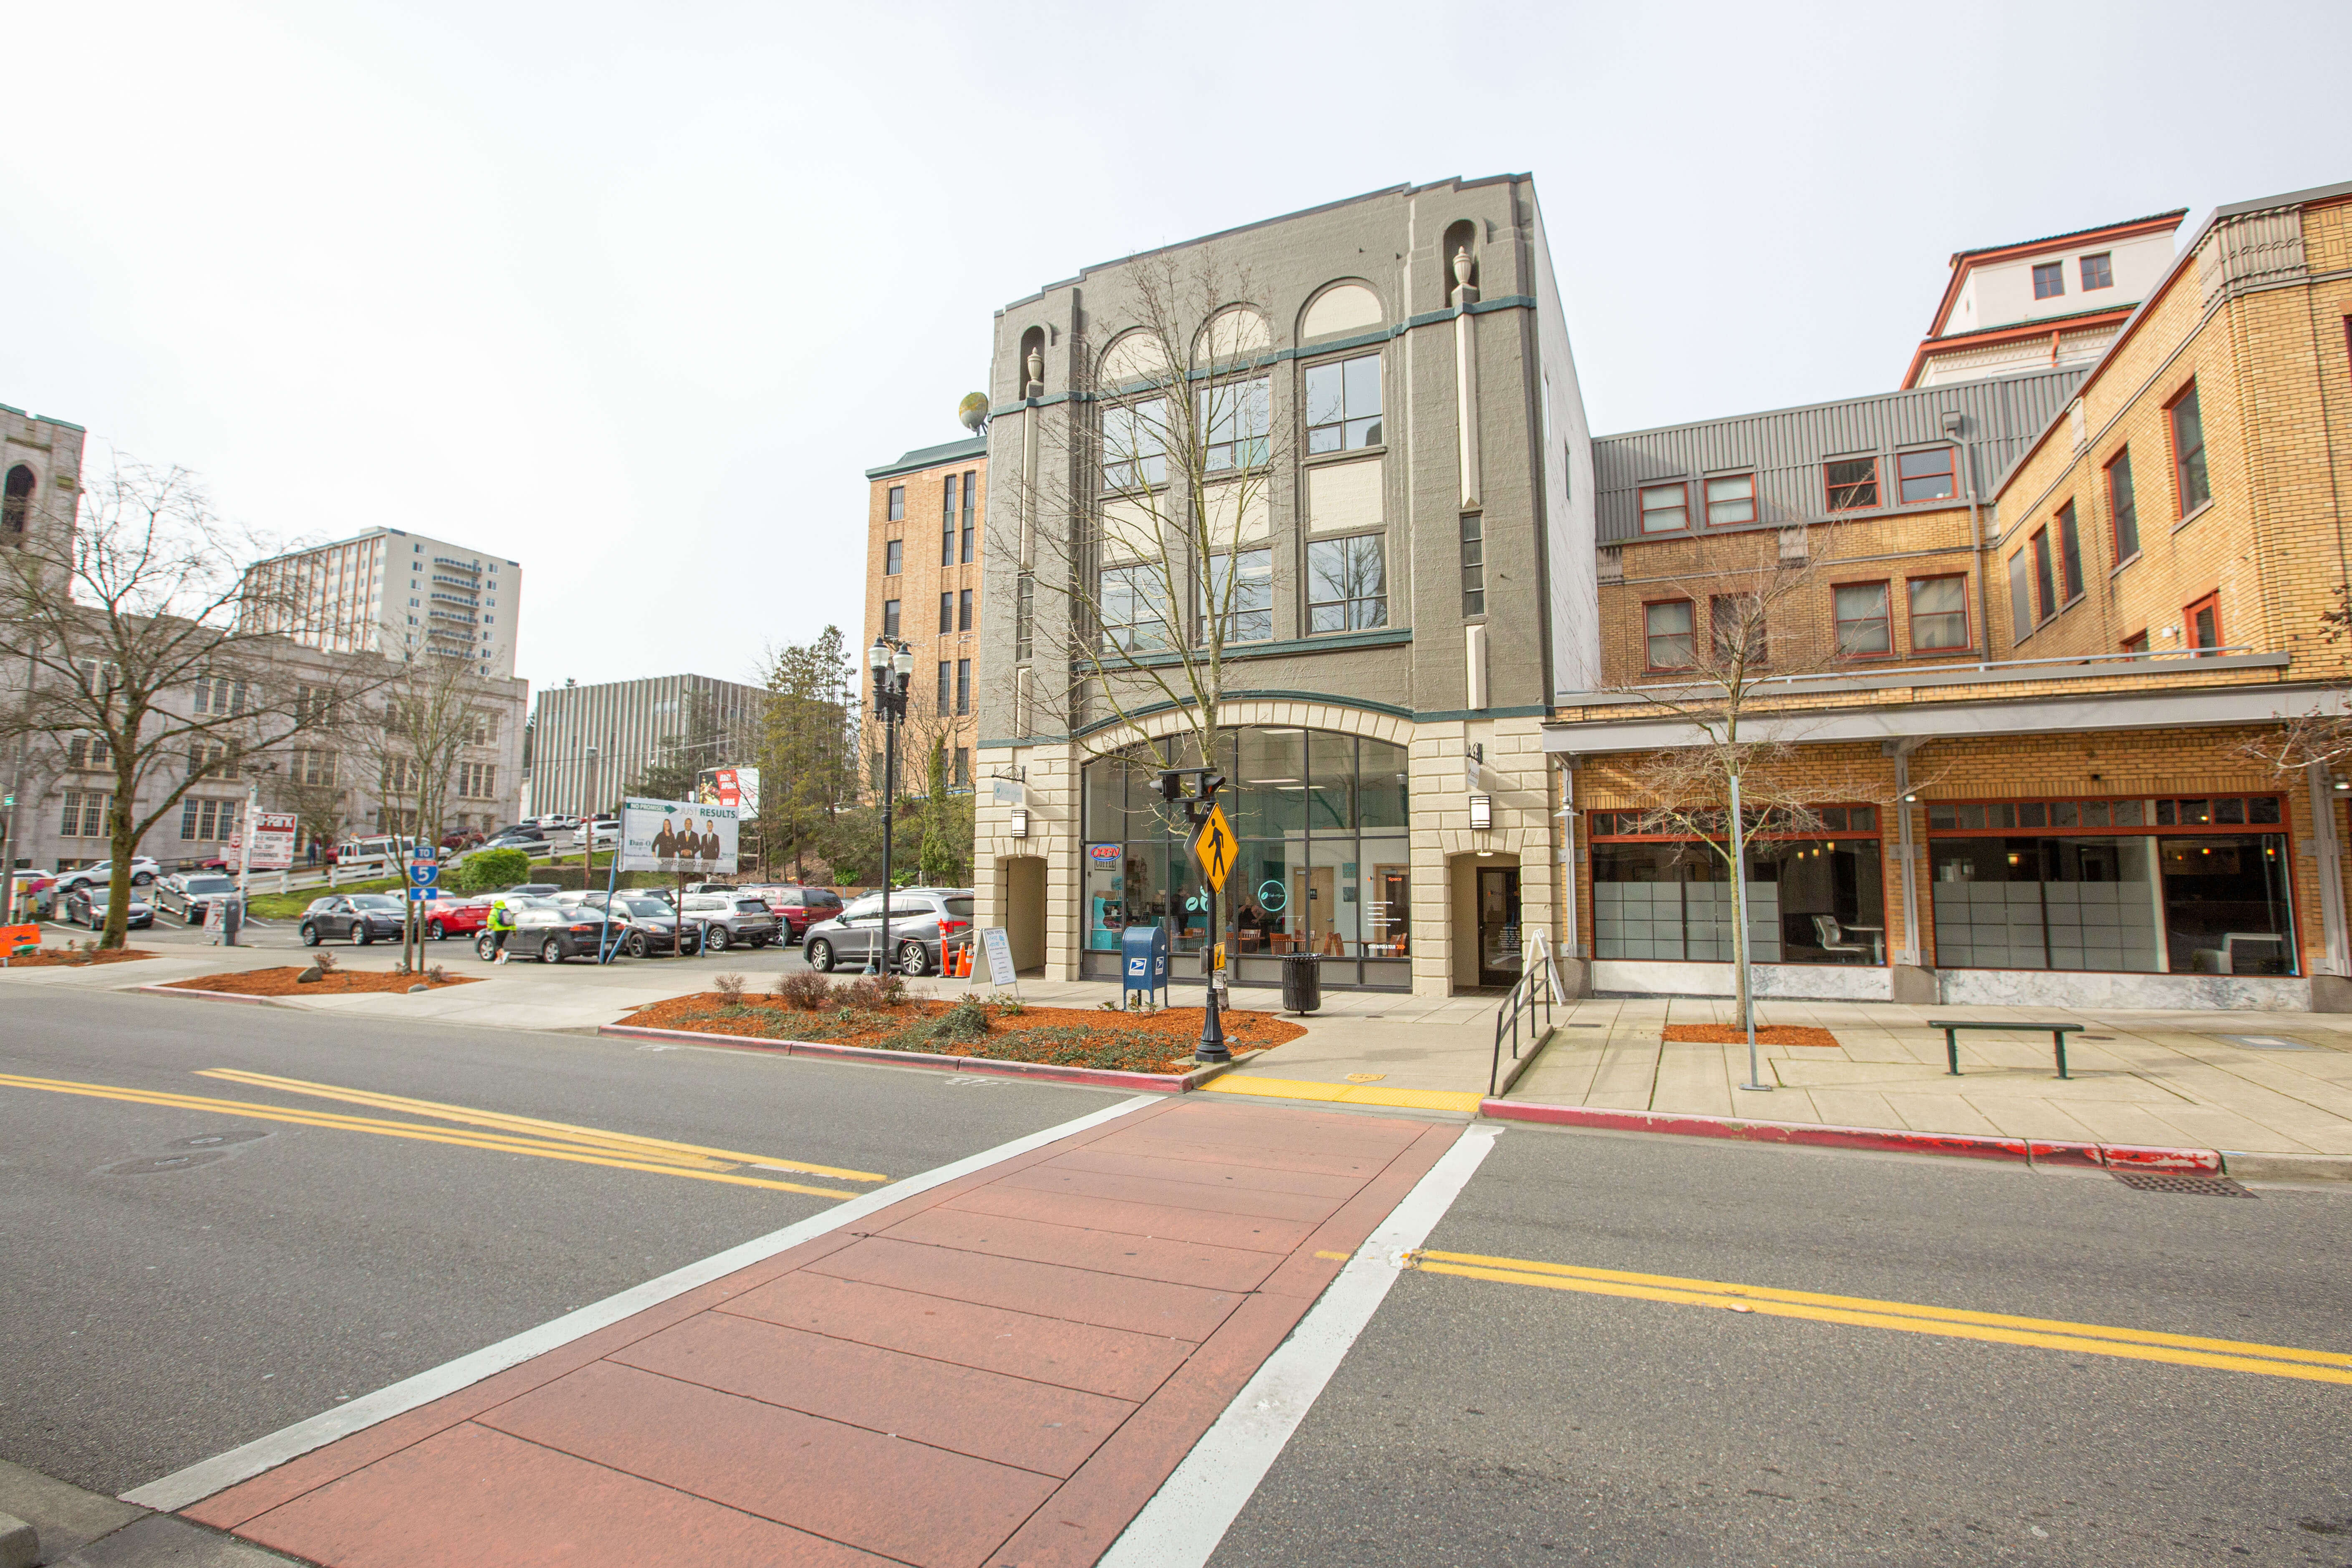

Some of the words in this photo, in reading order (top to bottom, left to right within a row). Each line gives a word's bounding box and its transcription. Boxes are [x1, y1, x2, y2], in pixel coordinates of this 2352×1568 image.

[679, 806, 699, 815] JUST
[700, 808, 738, 818] RESULTS.
[418, 848, 430, 857] TO
[1091, 847, 1120, 857] OPEN
[418, 867, 429, 881] 5
